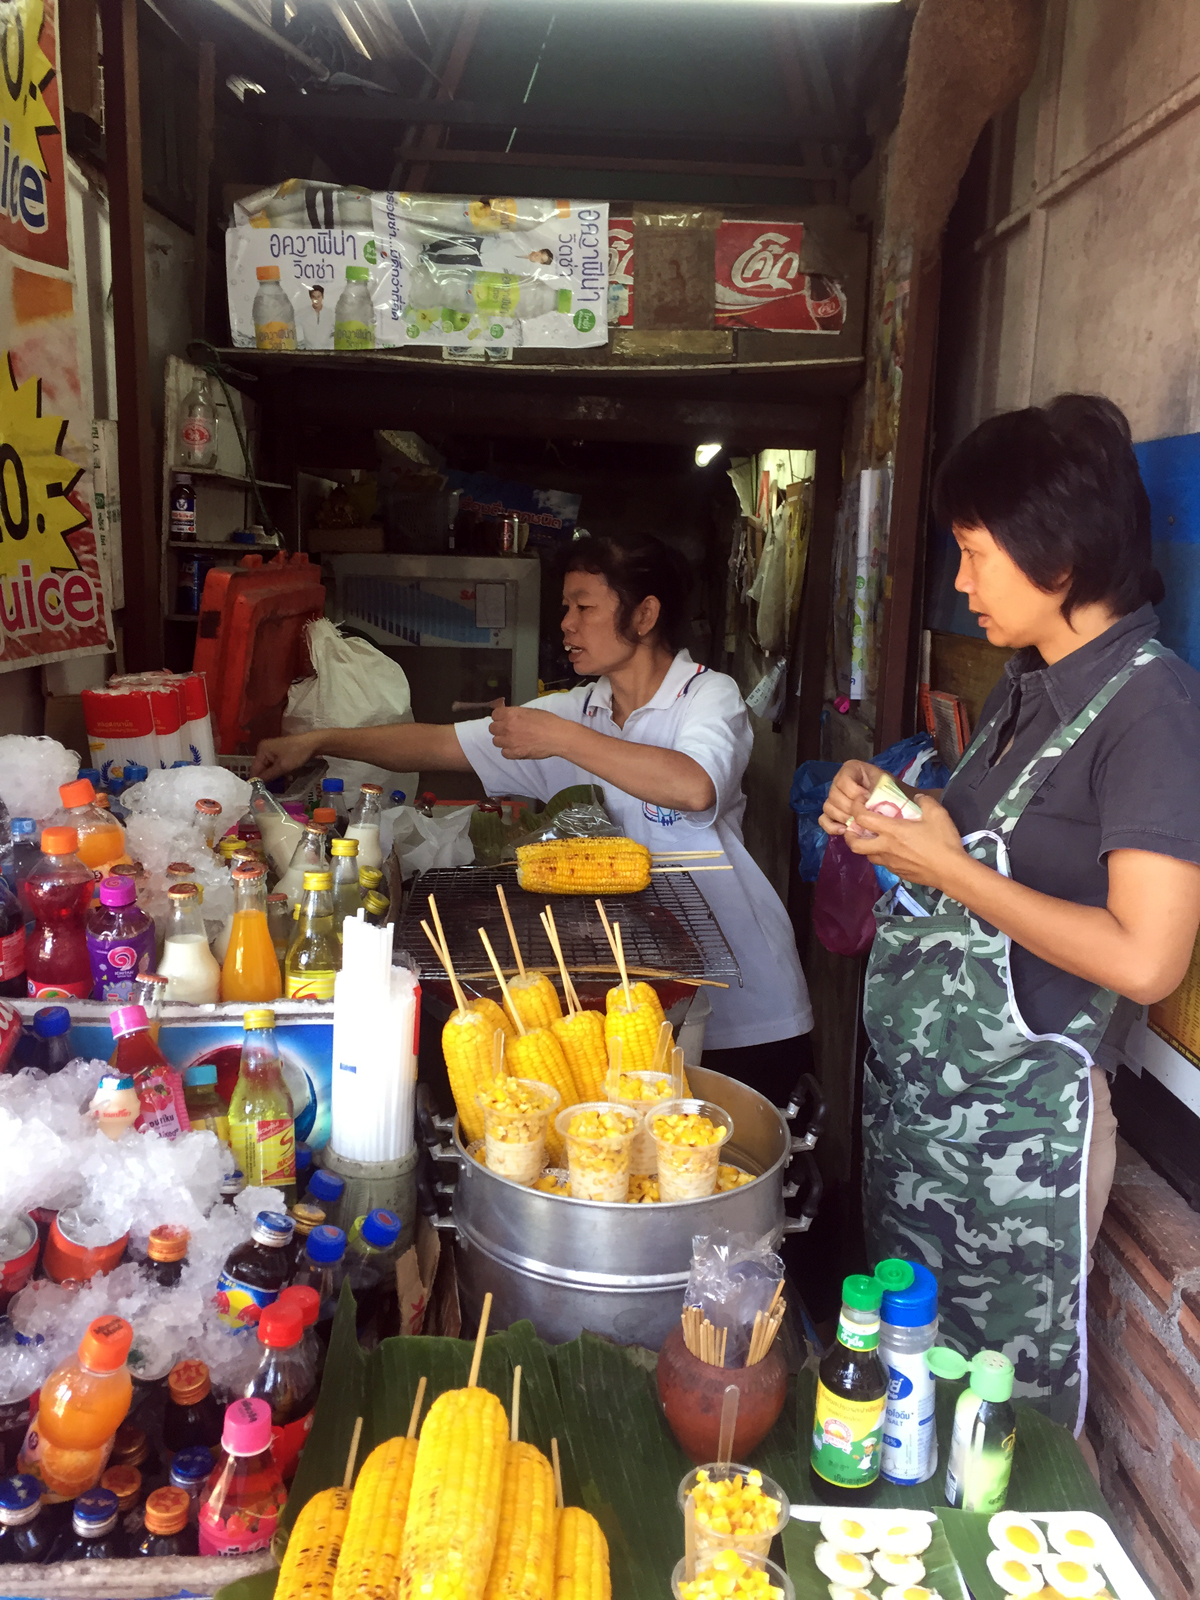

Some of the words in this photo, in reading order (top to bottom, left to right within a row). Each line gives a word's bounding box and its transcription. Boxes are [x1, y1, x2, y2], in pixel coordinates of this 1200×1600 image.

[270, 230, 357, 260] อควาฟีน่า
[0, 443, 63, 541] 0.-
